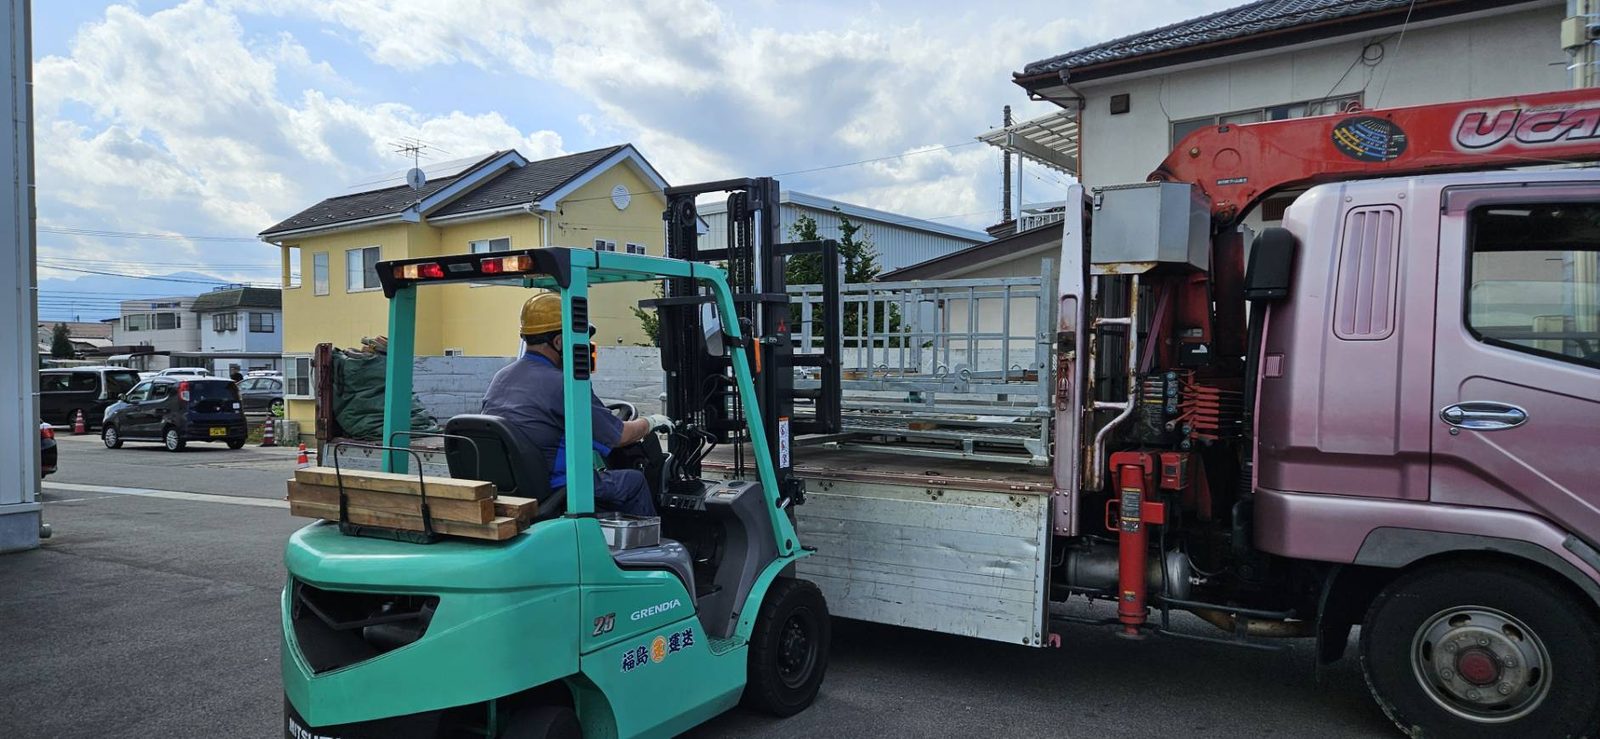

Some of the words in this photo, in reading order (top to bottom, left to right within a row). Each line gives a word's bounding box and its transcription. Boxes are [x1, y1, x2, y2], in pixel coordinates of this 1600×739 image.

[1455, 107, 1600, 149] UCA
[630, 599, 681, 621] GRENDIA
[593, 612, 616, 637] 25
